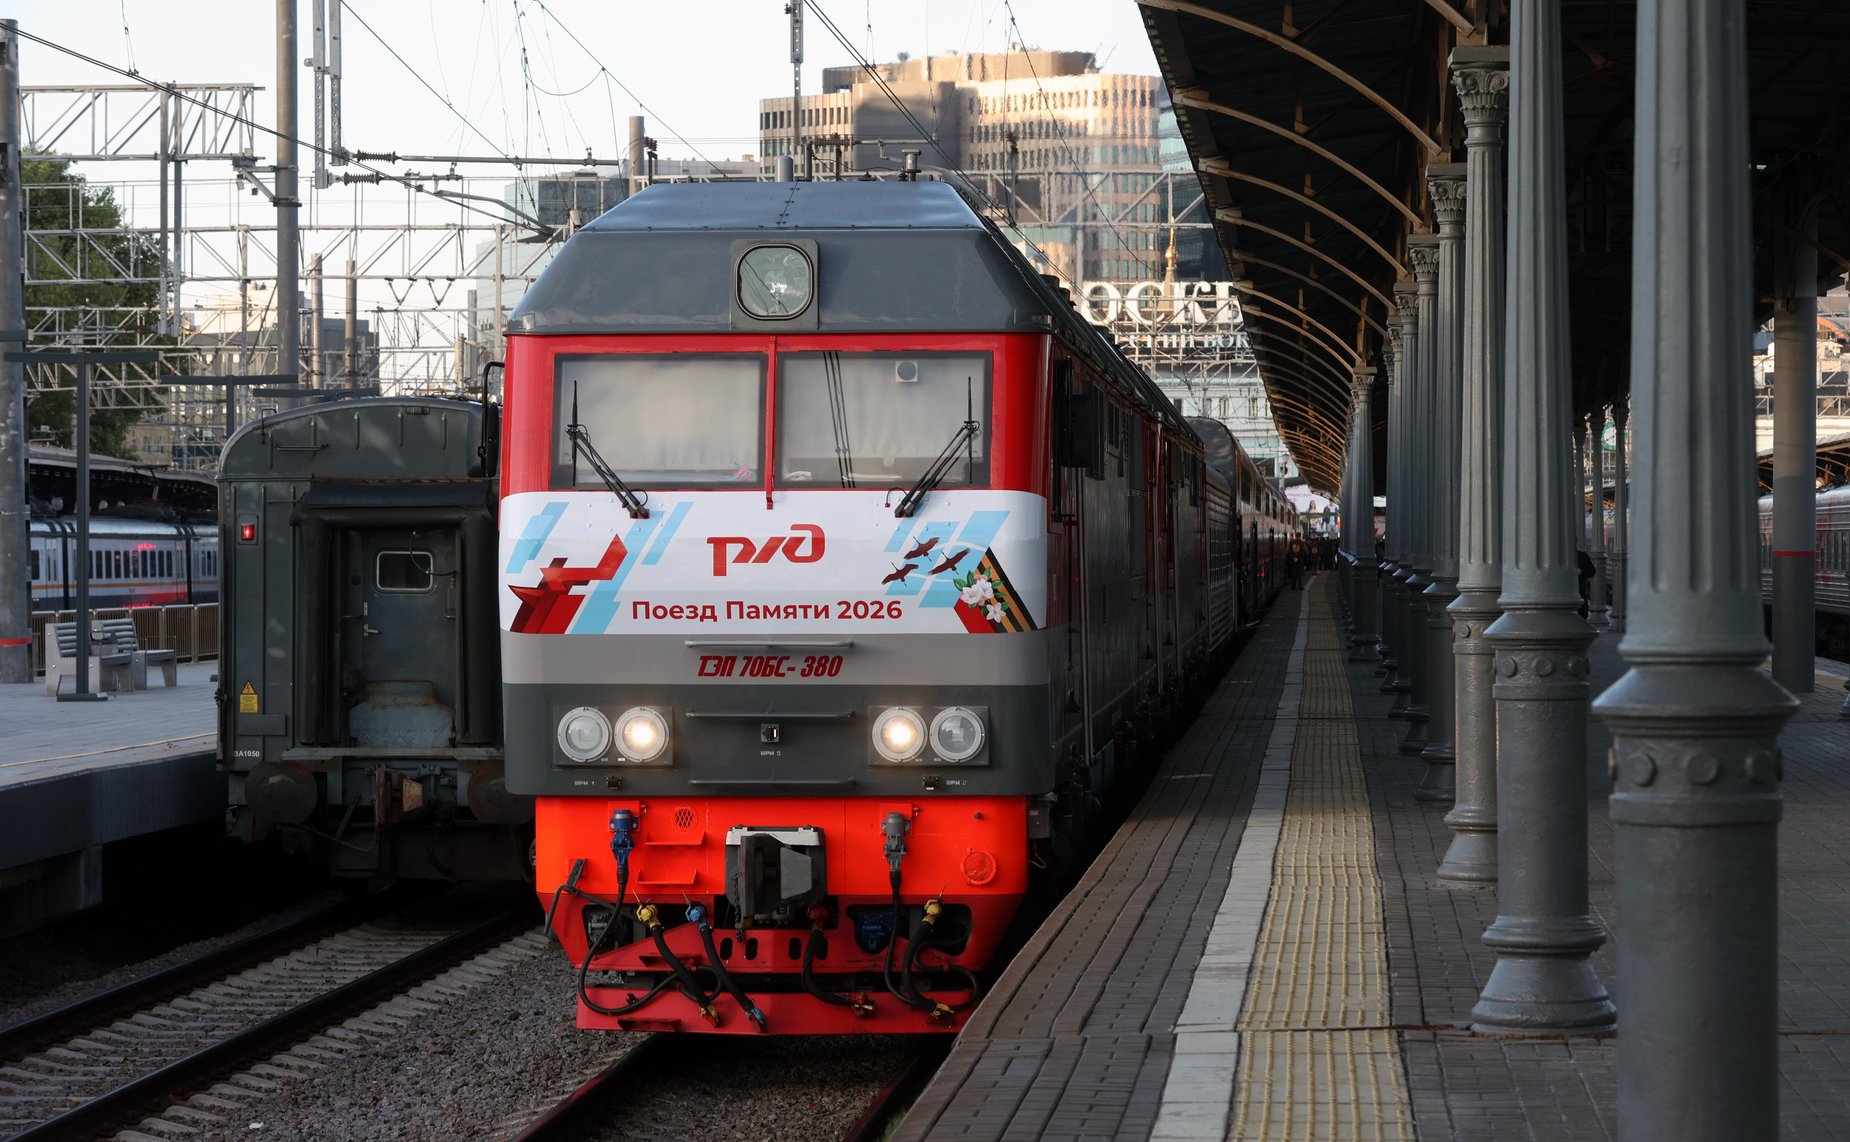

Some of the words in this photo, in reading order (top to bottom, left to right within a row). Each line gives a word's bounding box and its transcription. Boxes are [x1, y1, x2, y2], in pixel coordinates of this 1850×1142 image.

[706, 523, 826, 577] РЖД
[632, 600, 717, 622] Поезд
[726, 600, 829, 620] Памяти
[837, 600, 903, 620] 2026
[697, 655, 738, 677] ТЭП
[800, 655, 844, 677] 380
